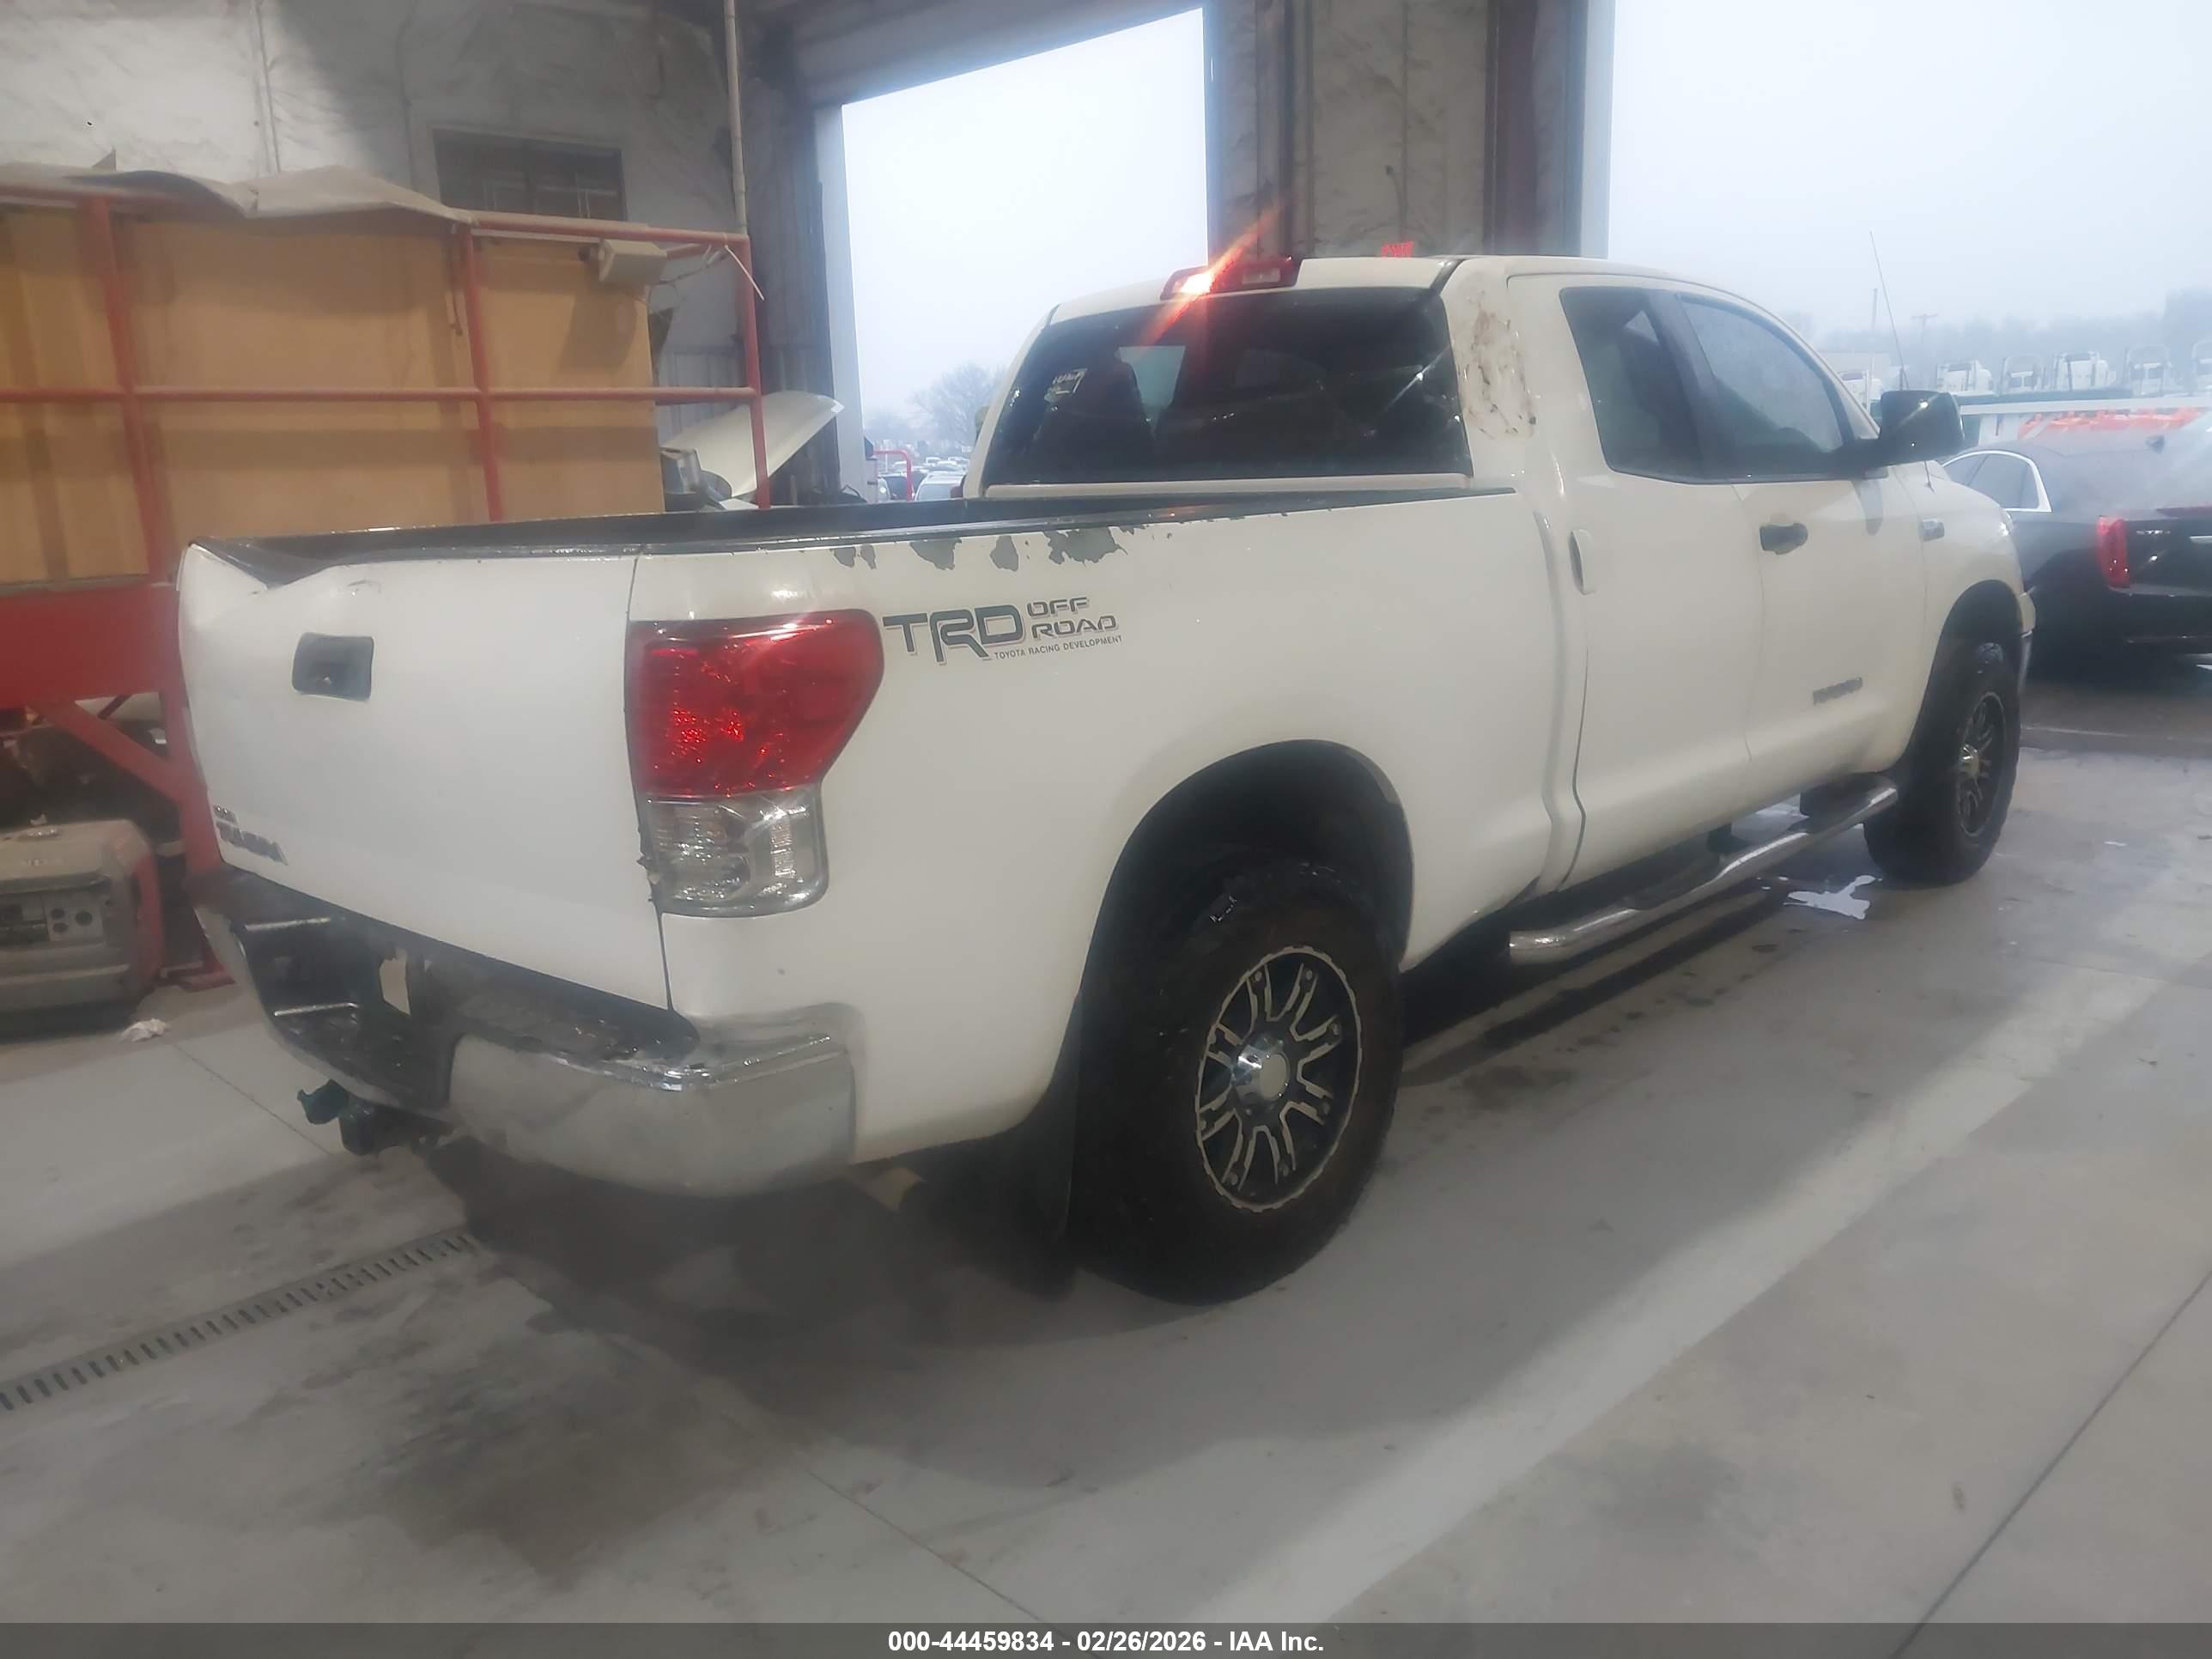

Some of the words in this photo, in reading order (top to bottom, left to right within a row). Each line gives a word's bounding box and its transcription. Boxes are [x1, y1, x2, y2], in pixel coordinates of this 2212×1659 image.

[1027, 597, 1090, 617] OFF
[882, 604, 1024, 663] TRD
[1031, 615, 1117, 639] ROAD
[994, 649, 1026, 660] TOYOTA
[1029, 644, 1060, 656] RACING
[1063, 635, 1123, 651] DEVELOPMENT
